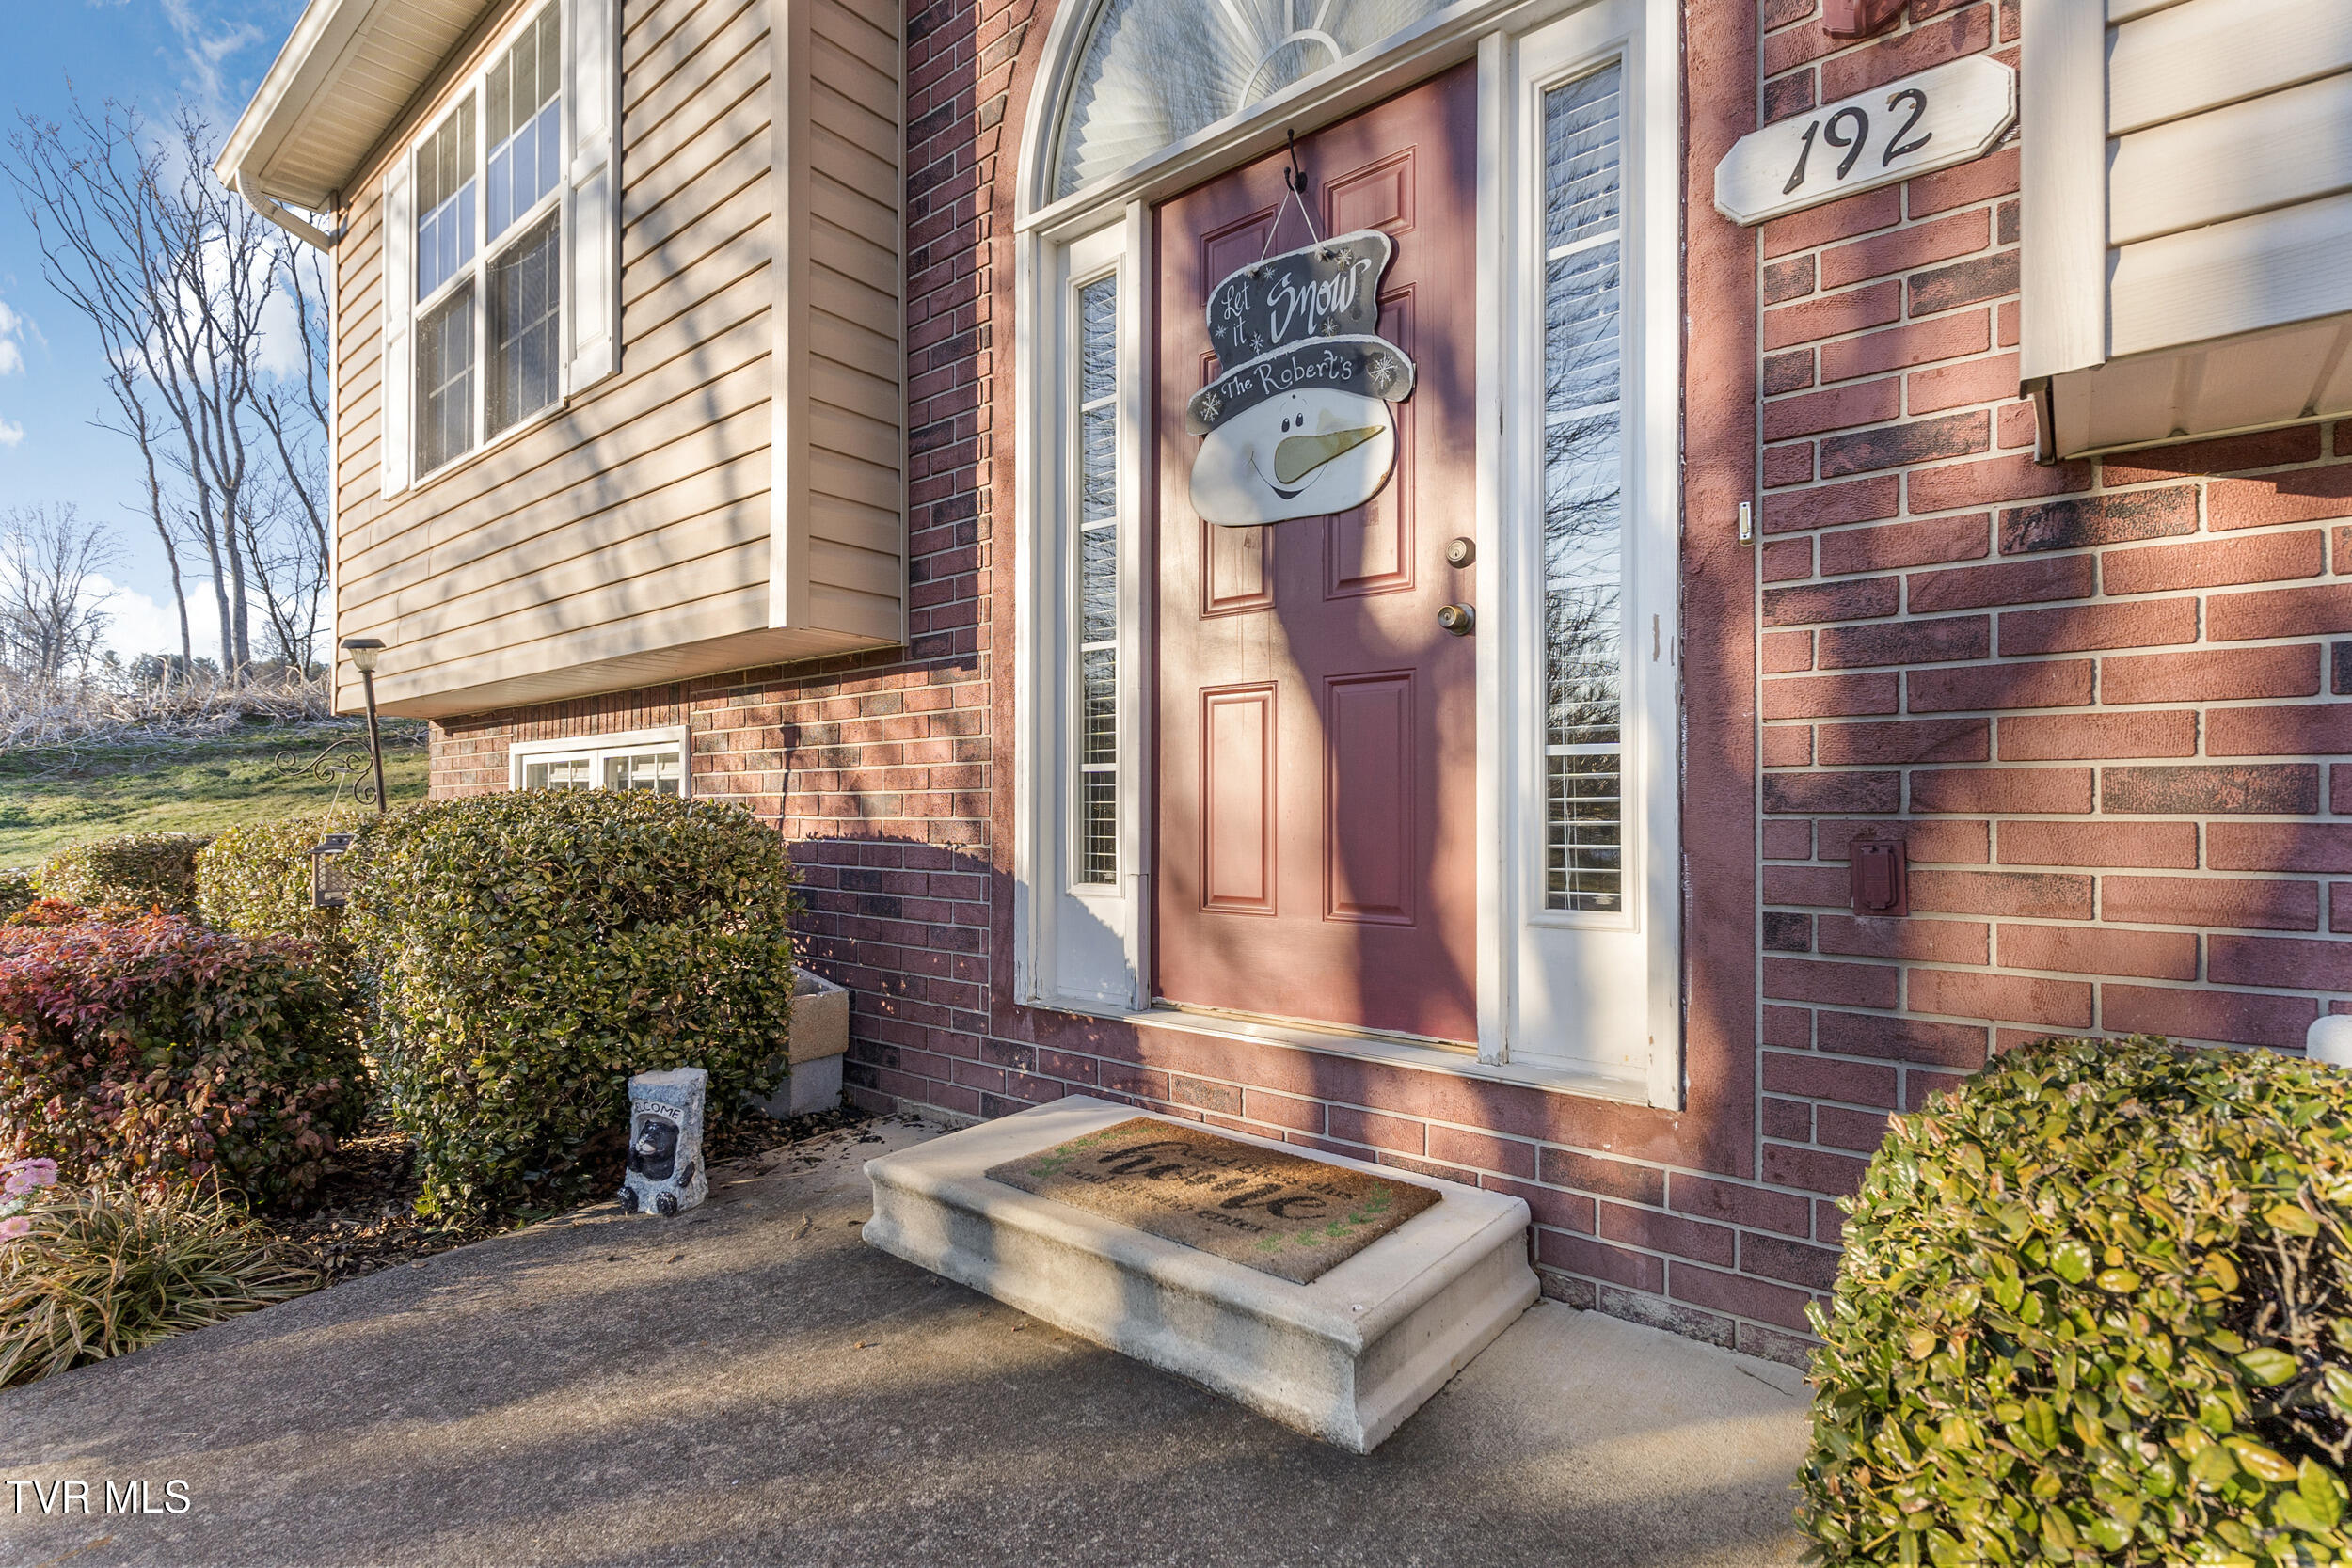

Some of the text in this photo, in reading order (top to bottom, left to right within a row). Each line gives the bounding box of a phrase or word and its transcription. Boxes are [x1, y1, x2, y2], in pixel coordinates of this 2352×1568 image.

[1782, 88, 1932, 195] 192
[1221, 281, 1251, 320] Let
[1266, 258, 1372, 344] Snow
[1232, 317, 1248, 347] it
[1221, 350, 1353, 400] The Robert's
[634, 1101, 681, 1119] ELCOME
